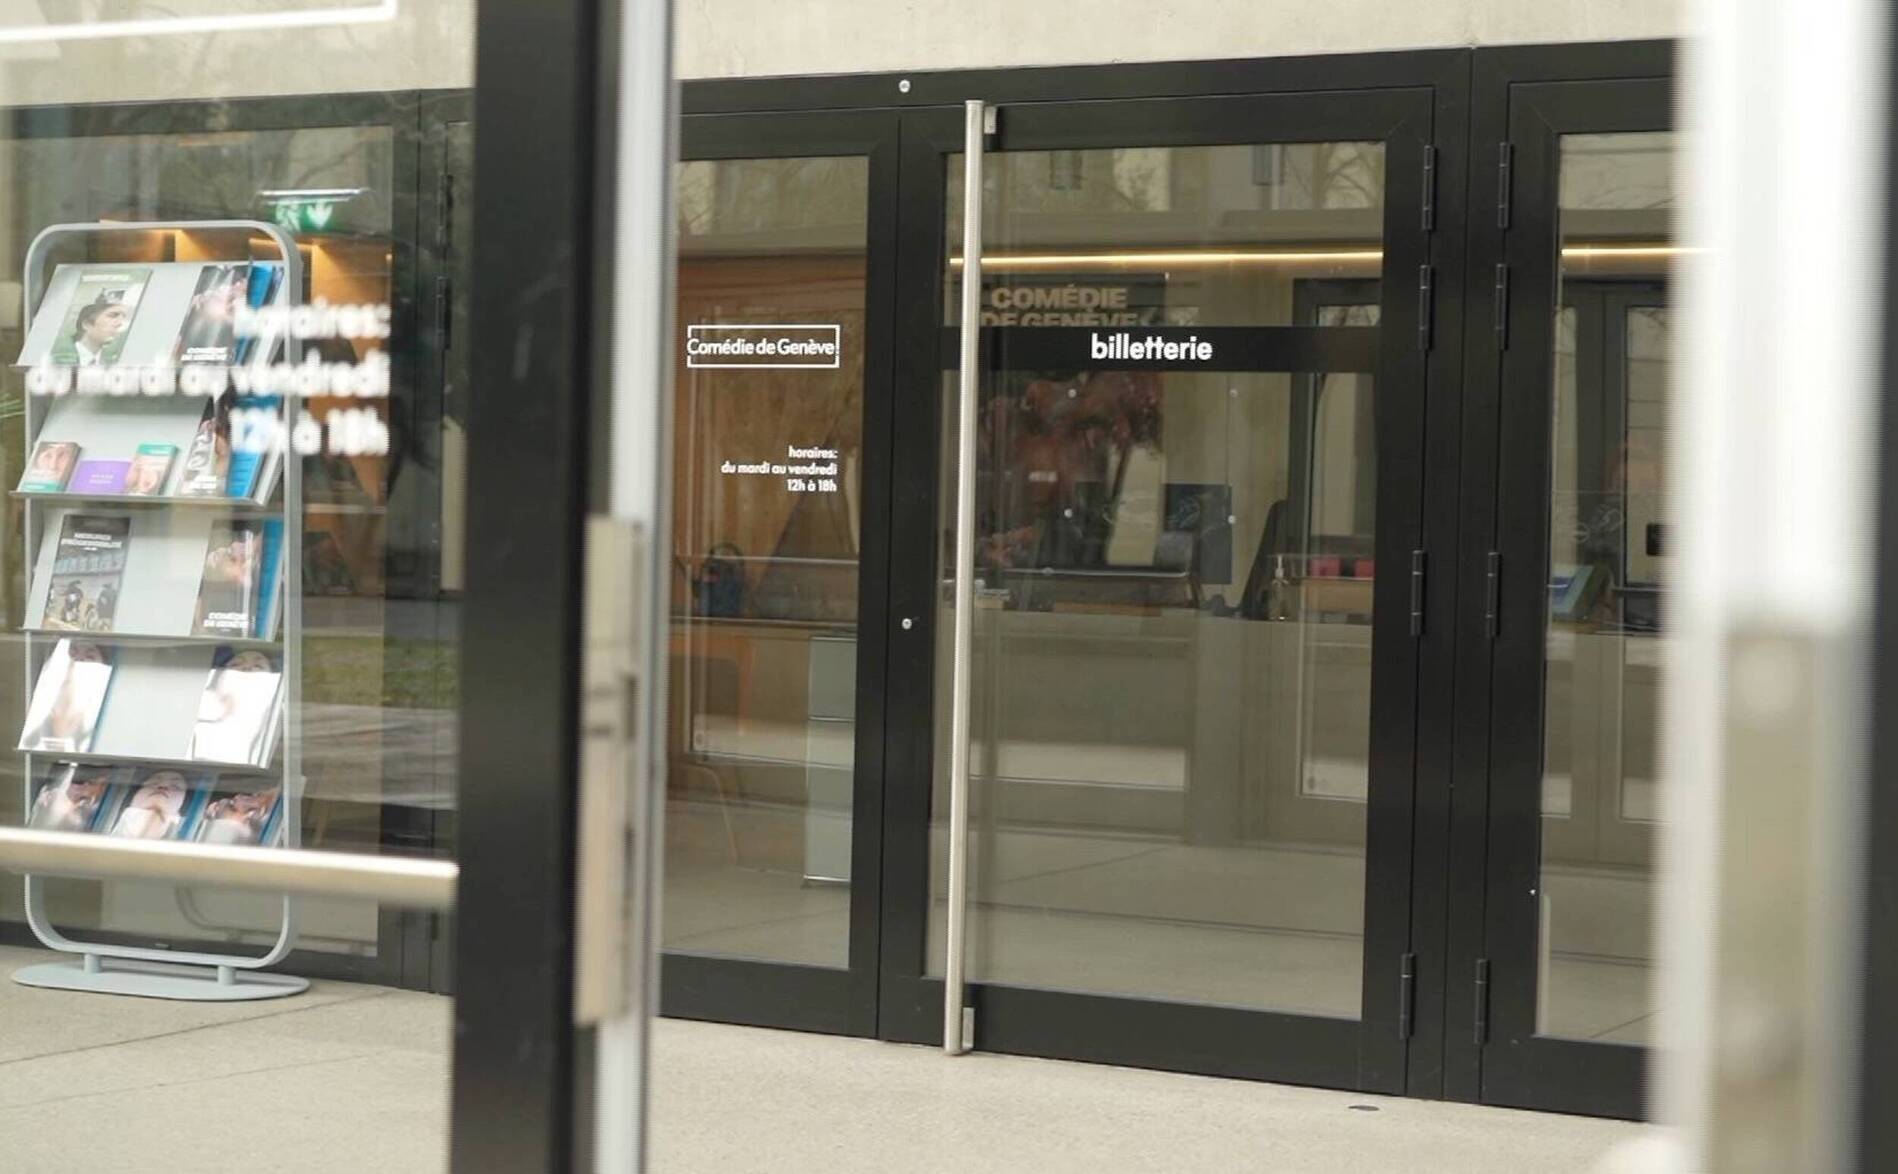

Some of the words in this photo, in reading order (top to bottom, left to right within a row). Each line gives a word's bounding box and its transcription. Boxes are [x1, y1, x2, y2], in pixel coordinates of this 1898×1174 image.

[990, 283, 1129, 309] COMÉDIE
[686, 338, 754, 355] Comédie
[755, 338, 776, 355] de
[777, 338, 835, 355] Genève
[1090, 332, 1214, 360] billetterie
[788, 445, 838, 459] horaires:
[721, 460, 736, 474] du
[737, 460, 770, 474] mardi
[771, 464, 787, 474] au
[787, 462, 838, 475] vendredi
[787, 478, 806, 492] 12h
[807, 480, 817, 492] à
[818, 478, 837, 492] 18h
